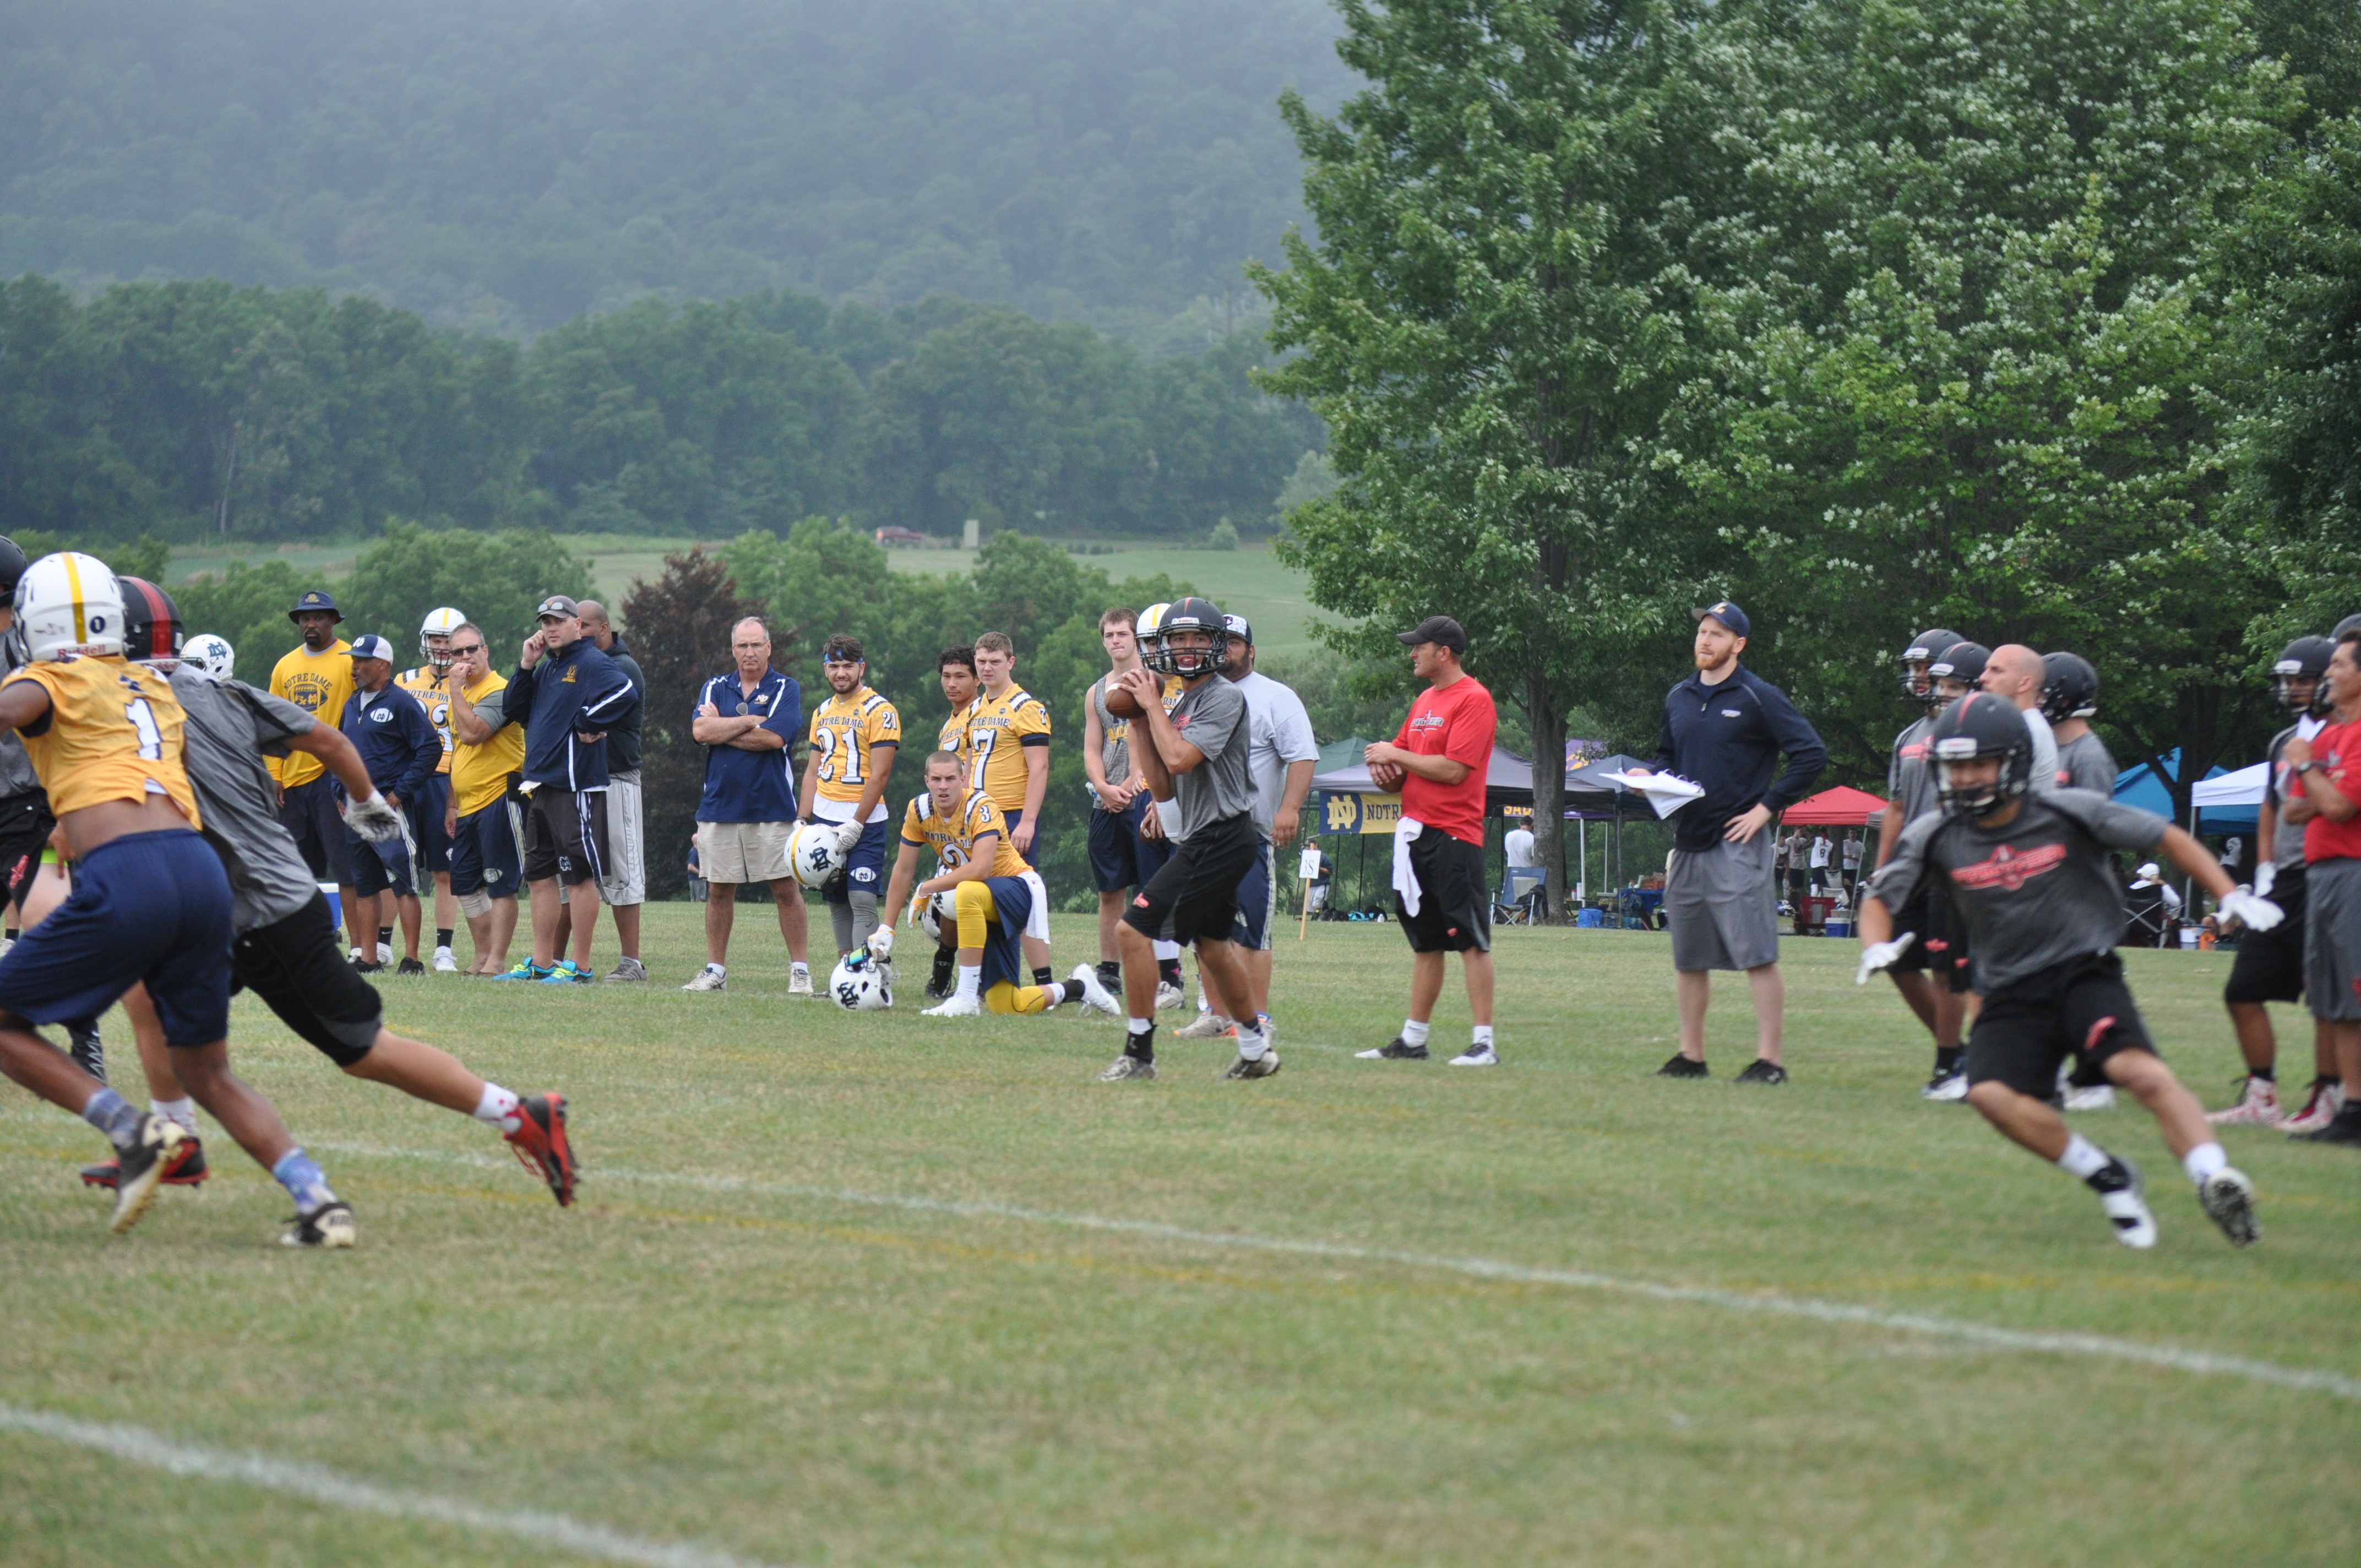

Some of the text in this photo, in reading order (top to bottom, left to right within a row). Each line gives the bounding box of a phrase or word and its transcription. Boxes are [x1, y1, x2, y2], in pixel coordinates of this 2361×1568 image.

[284, 673, 333, 692] NOTRE DAME
[437, 693, 449, 703] DA
[841, 717, 864, 728] DAME
[882, 710, 897, 731] 21
[988, 717, 1011, 727] DAME
[1038, 707, 1046, 726] 7
[124, 696, 163, 760] 1
[815, 727, 865, 785] 21
[972, 727, 998, 791] 7
[979, 805, 991, 823] 3
[1327, 795, 1402, 830] ND NOTR
